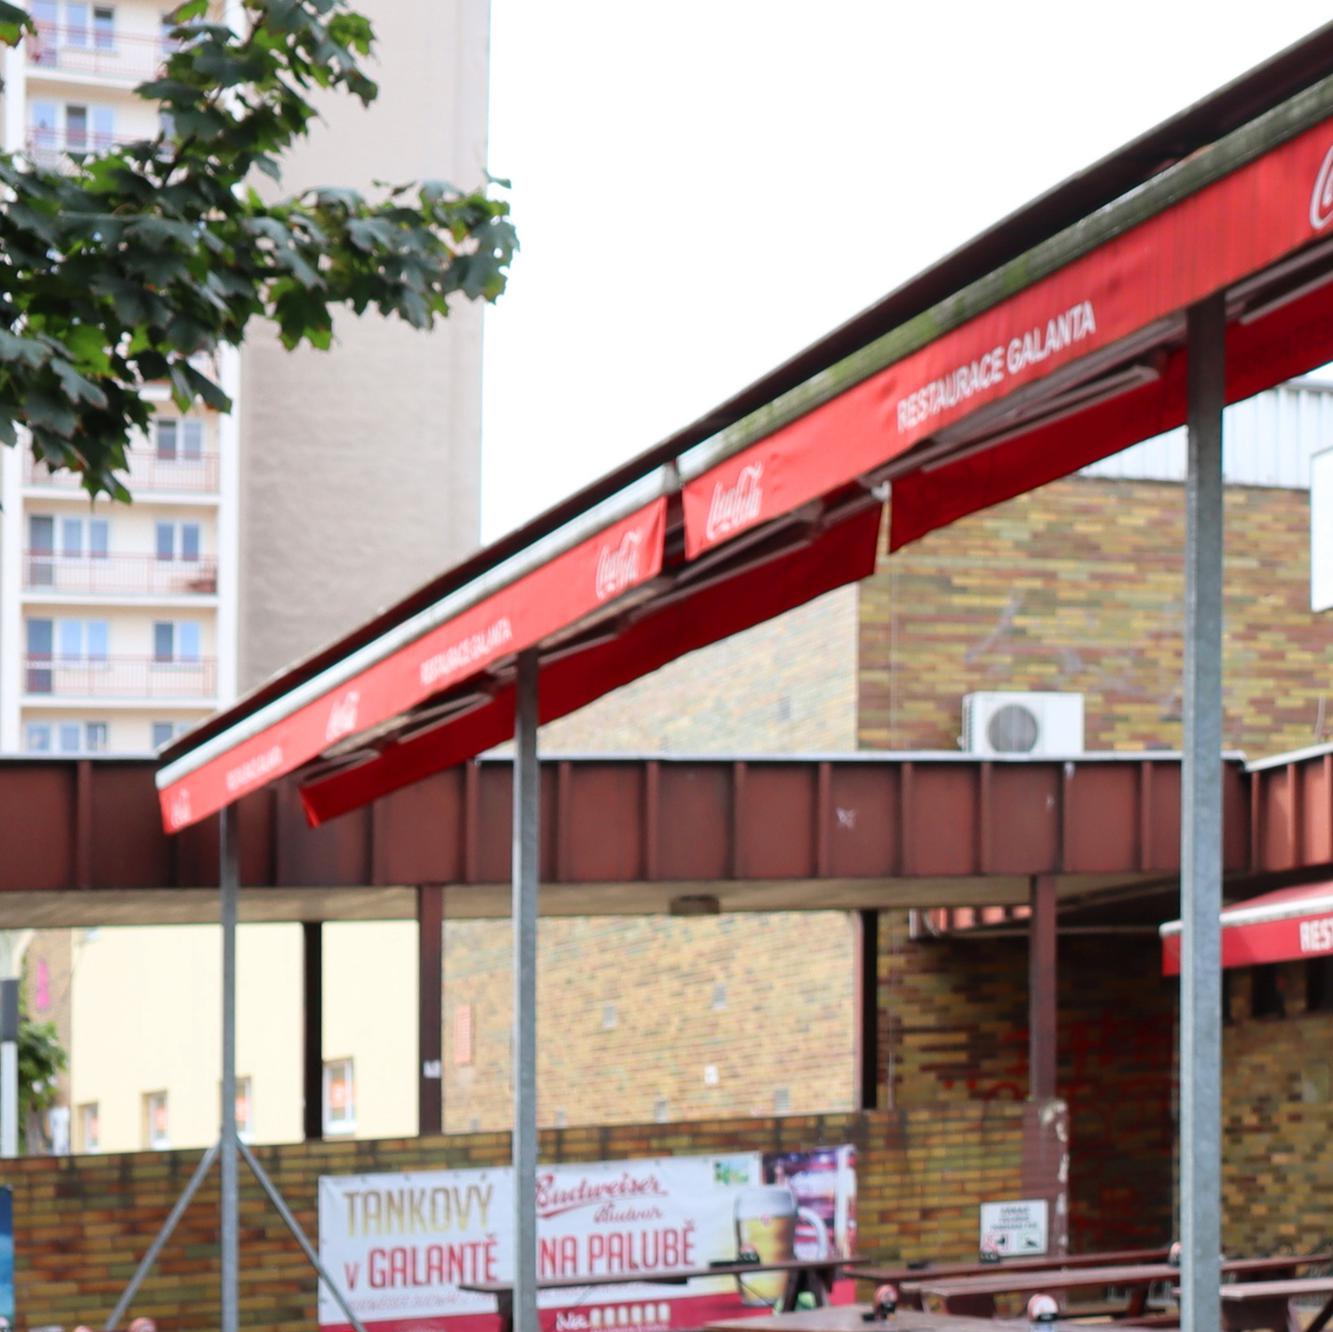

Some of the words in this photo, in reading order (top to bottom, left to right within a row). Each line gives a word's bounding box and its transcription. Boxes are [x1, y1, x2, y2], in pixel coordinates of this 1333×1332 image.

[896, 312, 1005, 434] RESTAURACE
[1007, 299, 1096, 376] GALANTA
[368, 1233, 498, 1289] GALANTĚ
[539, 1236, 578, 1276] NA
[587, 1219, 696, 1274] PALUBĚ
